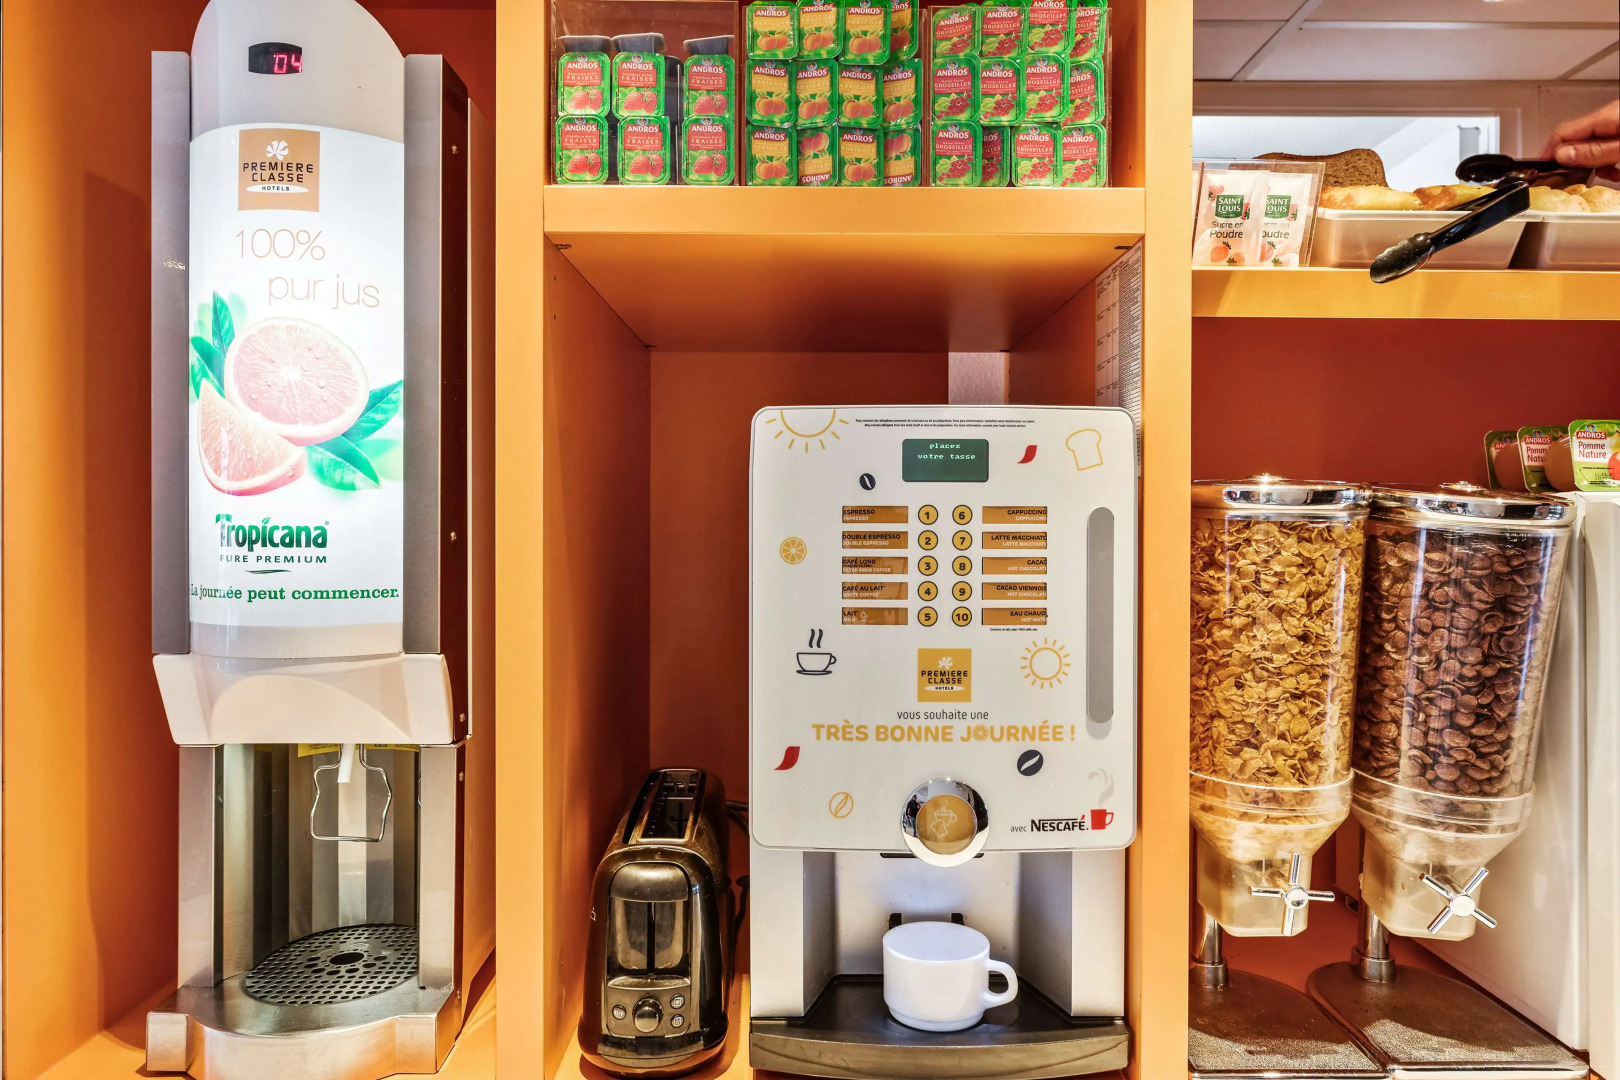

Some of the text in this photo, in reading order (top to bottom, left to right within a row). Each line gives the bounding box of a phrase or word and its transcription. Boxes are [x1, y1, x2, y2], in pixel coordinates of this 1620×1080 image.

[803, 3, 834, 12] ANDROS
[1033, 0, 1064, 8] ANDROS
[850, 7, 880, 15] ANDROS
[987, 10, 1018, 18] ANDROS
[1076, 8, 1094, 18] DROS
[939, 14, 969, 26] ANDROS
[983, 22, 1020, 30] GROSEILLES
[567, 62, 598, 70] ANDROS
[621, 62, 653, 71] ANDROS
[692, 65, 724, 74] ANDROS
[1026, 66, 1057, 74] ANDROS
[754, 66, 786, 77] ANDROS
[797, 68, 827, 79] ANDROS
[842, 70, 872, 80] ANDROS
[883, 71, 912, 81] ANDROS
[936, 69, 968, 77] ANDROS
[982, 70, 1013, 78] ANDROS
[1070, 73, 1091, 83] DROS
[564, 124, 596, 133] ANDROS
[627, 124, 659, 133] ANDROS
[691, 124, 722, 133] ANDROS
[754, 132, 785, 140] ANDROS
[843, 134, 873, 142] ANDROS
[938, 131, 969, 139] ANDROS
[984, 134, 998, 142] ROS
[1018, 134, 1049, 142] ANDROS
[1062, 135, 1094, 143] ANDROS
[243, 162, 314, 174] PREMIERE
[251, 172, 304, 183] CLASSE
[802, 174, 830, 183] ANDROS
[884, 174, 912, 184] ANDROS
[1218, 196, 1242, 205] SAINT
[1218, 204, 1241, 214] LOUIS
[1267, 205, 1288, 213] OUIS
[1211, 220, 1233, 229] Sucre
[1209, 229, 1244, 239] Poudre
[1262, 230, 1290, 239] oudre
[236, 228, 326, 261] 100%
[269, 273, 380, 310] pur jus
[1577, 431, 1606, 439] ANDROS
[929, 442, 961, 451] placez
[1526, 446, 1547, 454] Pomm
[1578, 441, 1606, 450] Pomme
[1527, 454, 1545, 463] Natu
[1578, 450, 1607, 459] Nature
[924, 511, 930, 520] 1
[958, 511, 966, 520] 6
[924, 537, 932, 545] 2
[959, 537, 966, 546] 7
[219, 554, 328, 564] PURE PREMIUM
[924, 562, 931, 571] 3
[958, 562, 966, 571] 8
[190, 583, 400, 603] La journée peut commencer.
[924, 587, 932, 596] 4
[958, 587, 966, 596] 9
[924, 612, 931, 621] 5
[955, 613, 969, 622] 10
[920, 670, 969, 678] PREMIERE
[927, 677, 963, 685] CLASSE
[897, 709, 989, 720] vous souhaite une
[811, 719, 1076, 742] TRÈS BONNE JOURNÉE !
[1010, 824, 1027, 833] avec
